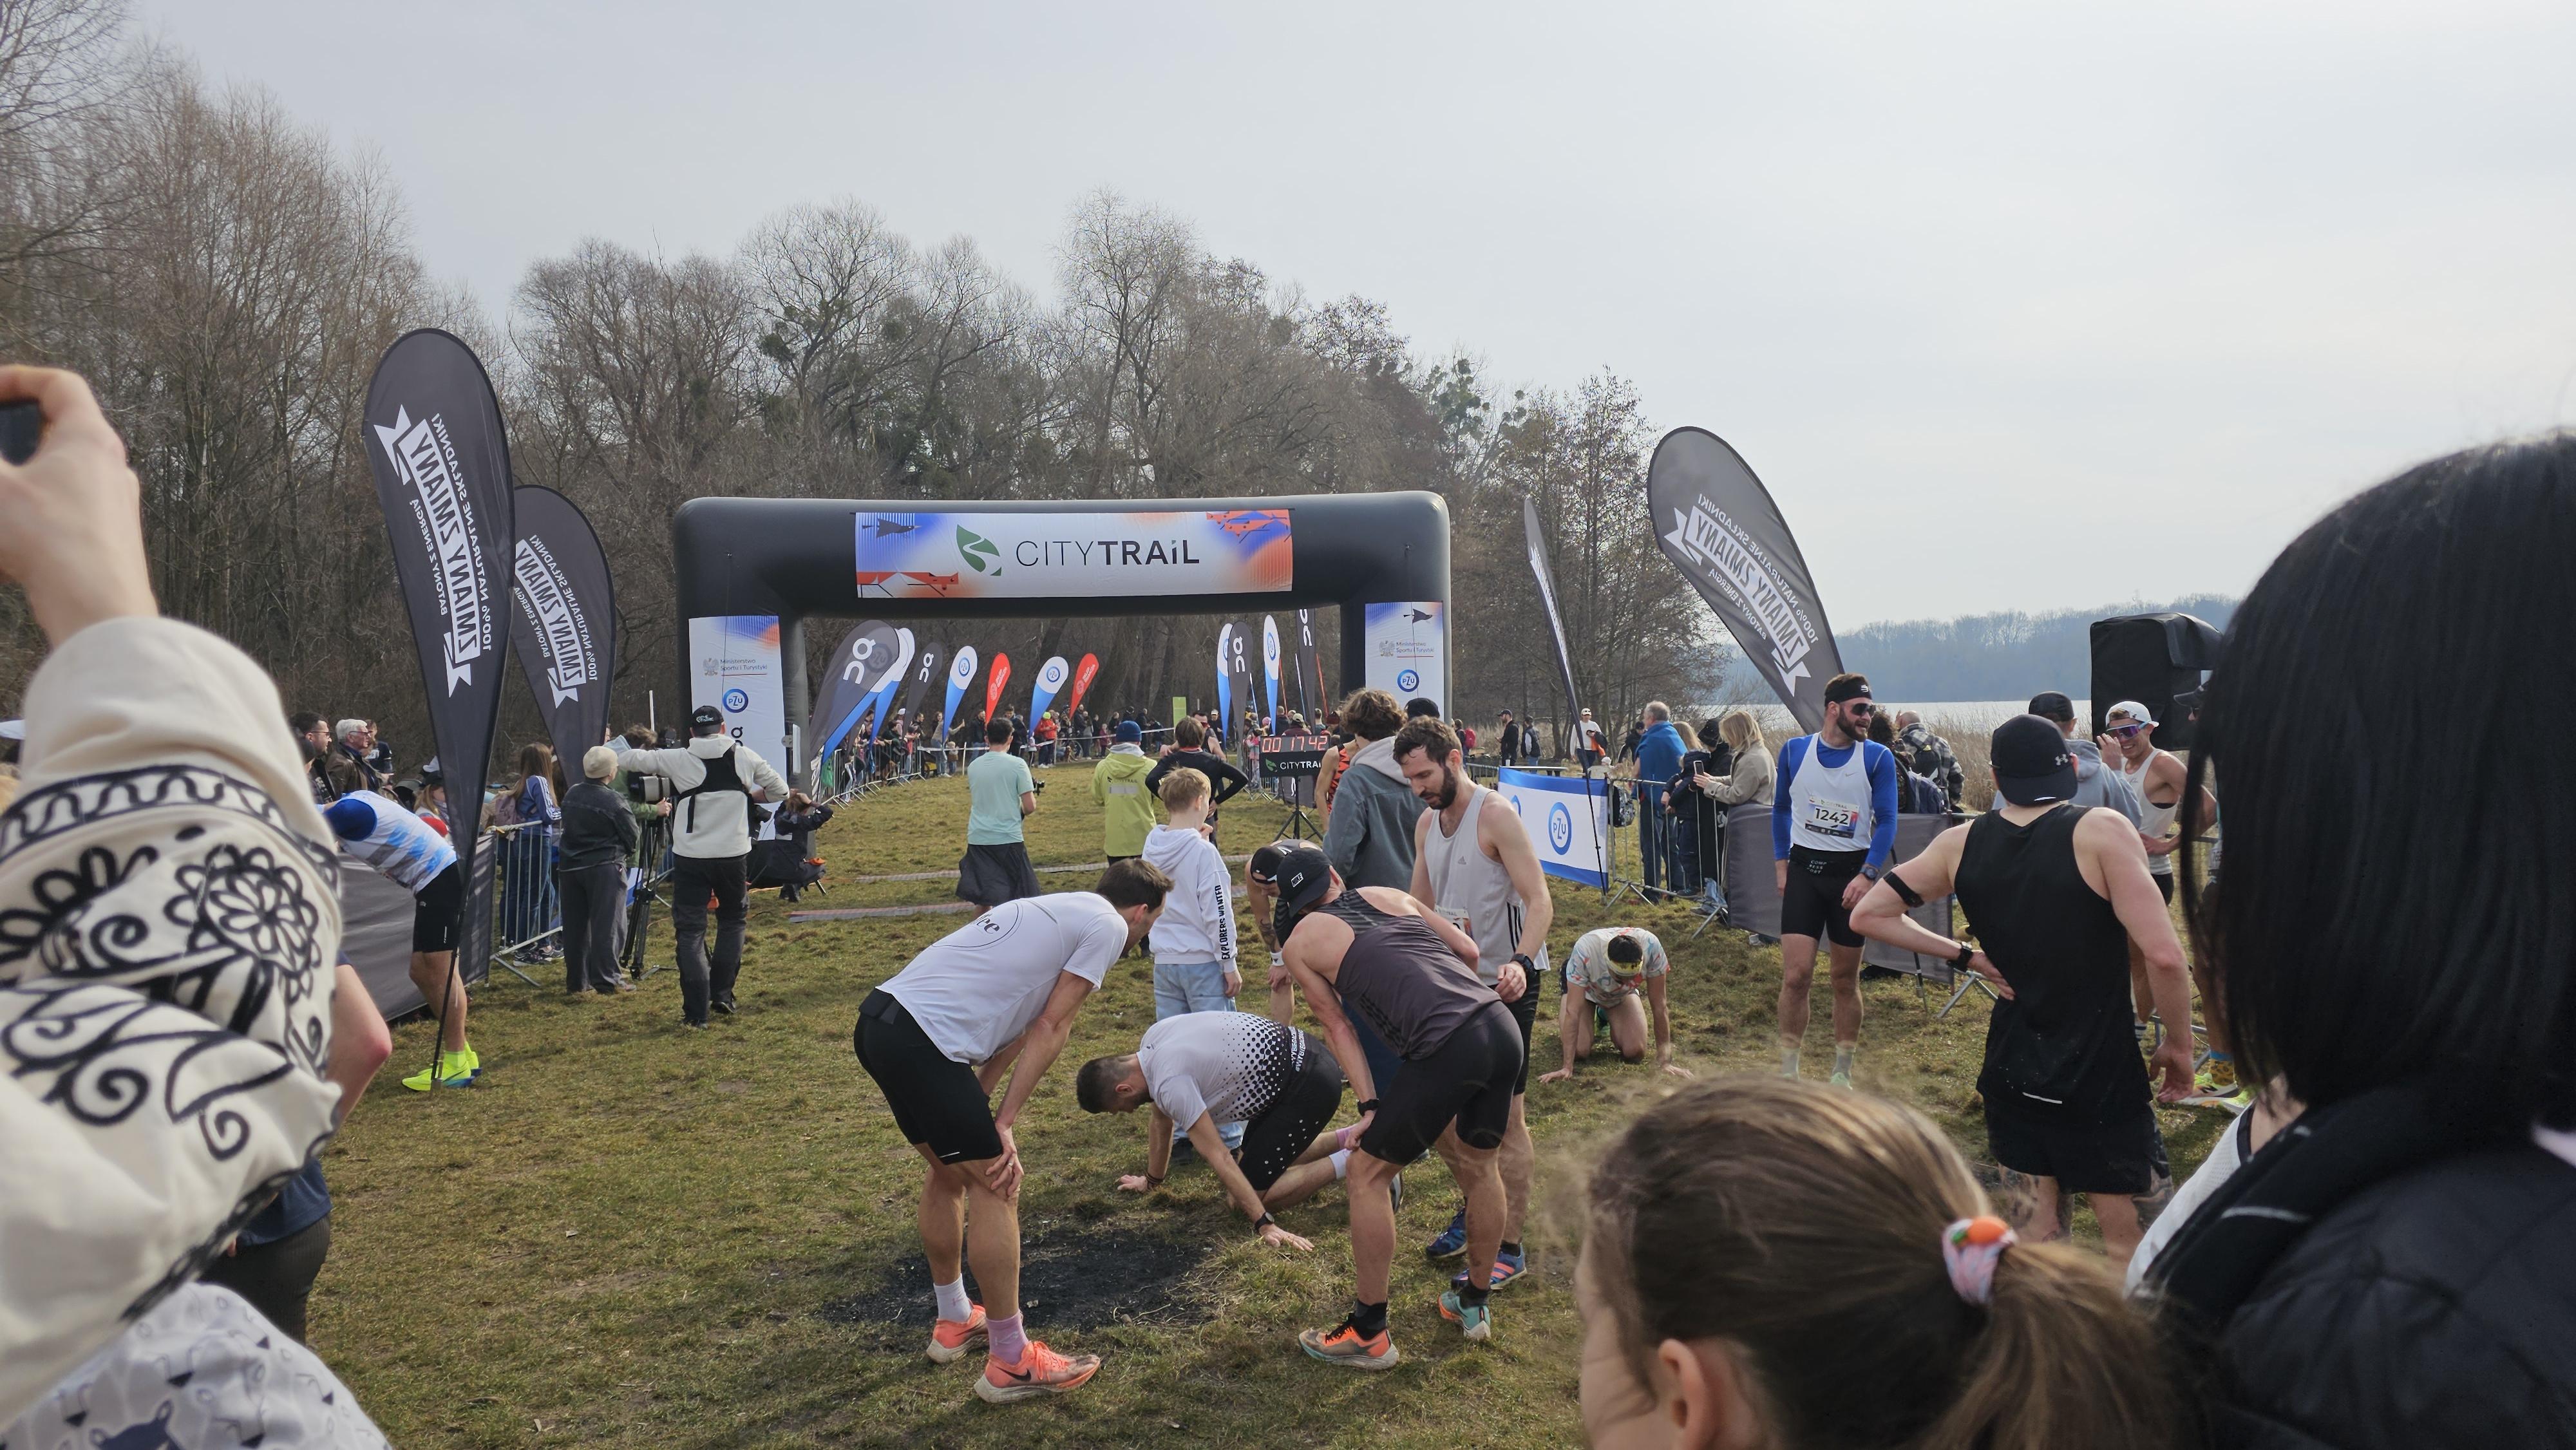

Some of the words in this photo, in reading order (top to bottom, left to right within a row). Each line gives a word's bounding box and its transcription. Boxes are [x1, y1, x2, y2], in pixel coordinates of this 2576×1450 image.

[1402, 676, 1415, 686] PZU
[728, 695, 743, 706] PZU
[1815, 807, 1849, 825] 1242
[1553, 818, 1566, 840] PZU
[1219, 918, 1231, 960] EXPLORERS
